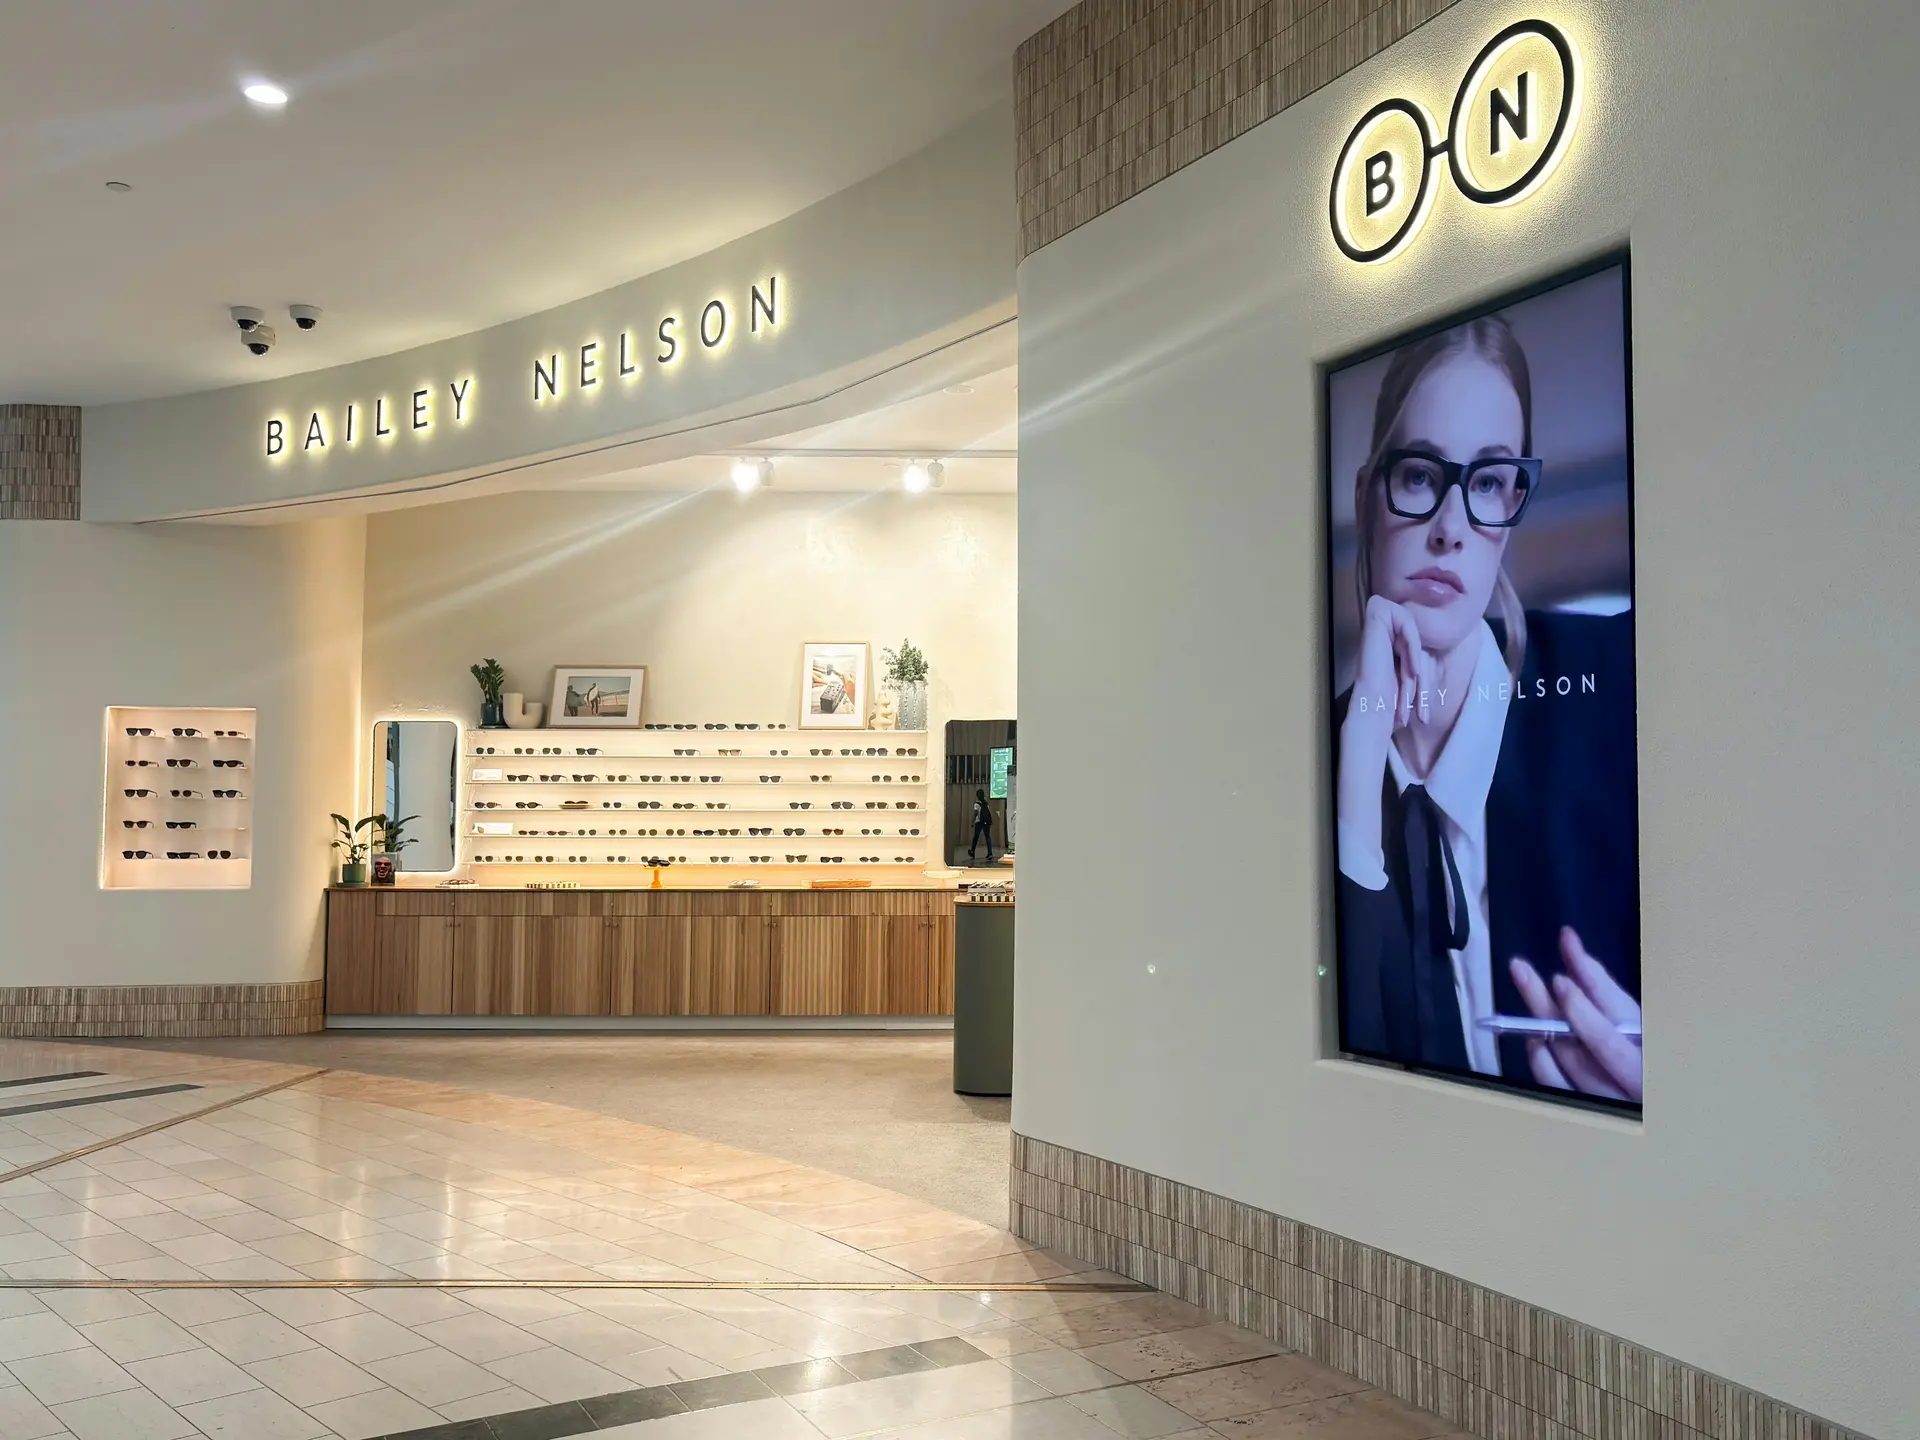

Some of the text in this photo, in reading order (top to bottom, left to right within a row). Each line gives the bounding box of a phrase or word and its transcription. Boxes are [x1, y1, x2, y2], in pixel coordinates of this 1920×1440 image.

[266, 276, 777, 456] BAILEY NELSON
[1360, 673, 1596, 713] BAILEY NELSON
